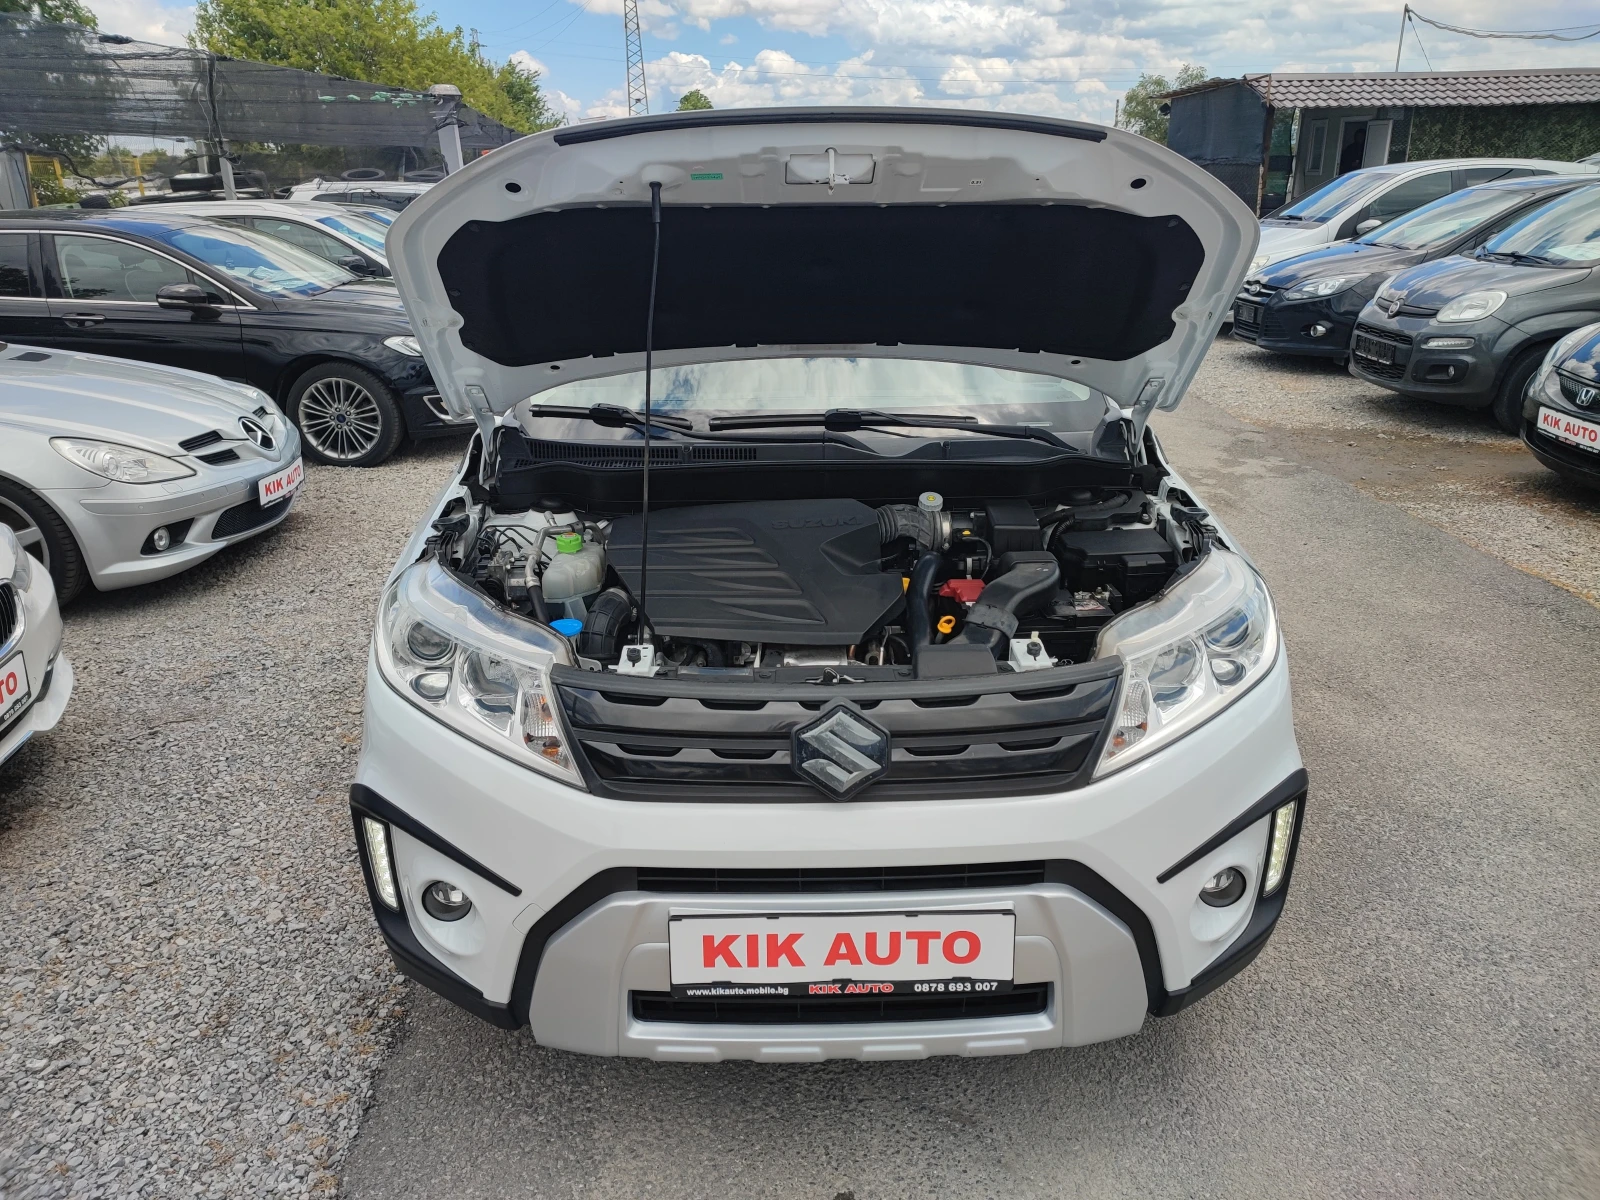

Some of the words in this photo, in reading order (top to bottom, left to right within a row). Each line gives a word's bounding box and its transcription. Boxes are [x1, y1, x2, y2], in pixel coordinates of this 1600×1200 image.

[1543, 413, 1561, 430] KIK
[1564, 421, 1597, 442] AUTO
[265, 477, 284, 497] KIK
[286, 464, 301, 487] AUTO
[702, 933, 806, 968] KIK
[823, 930, 982, 967] AUTO
[686, 986, 789, 996] www.kikauto.mobile.bg
[808, 984, 842, 995] KIK
[844, 983, 895, 994] AUTO
[914, 983, 945, 993] 0878
[948, 983, 972, 992] 693
[975, 982, 998, 991] 007
